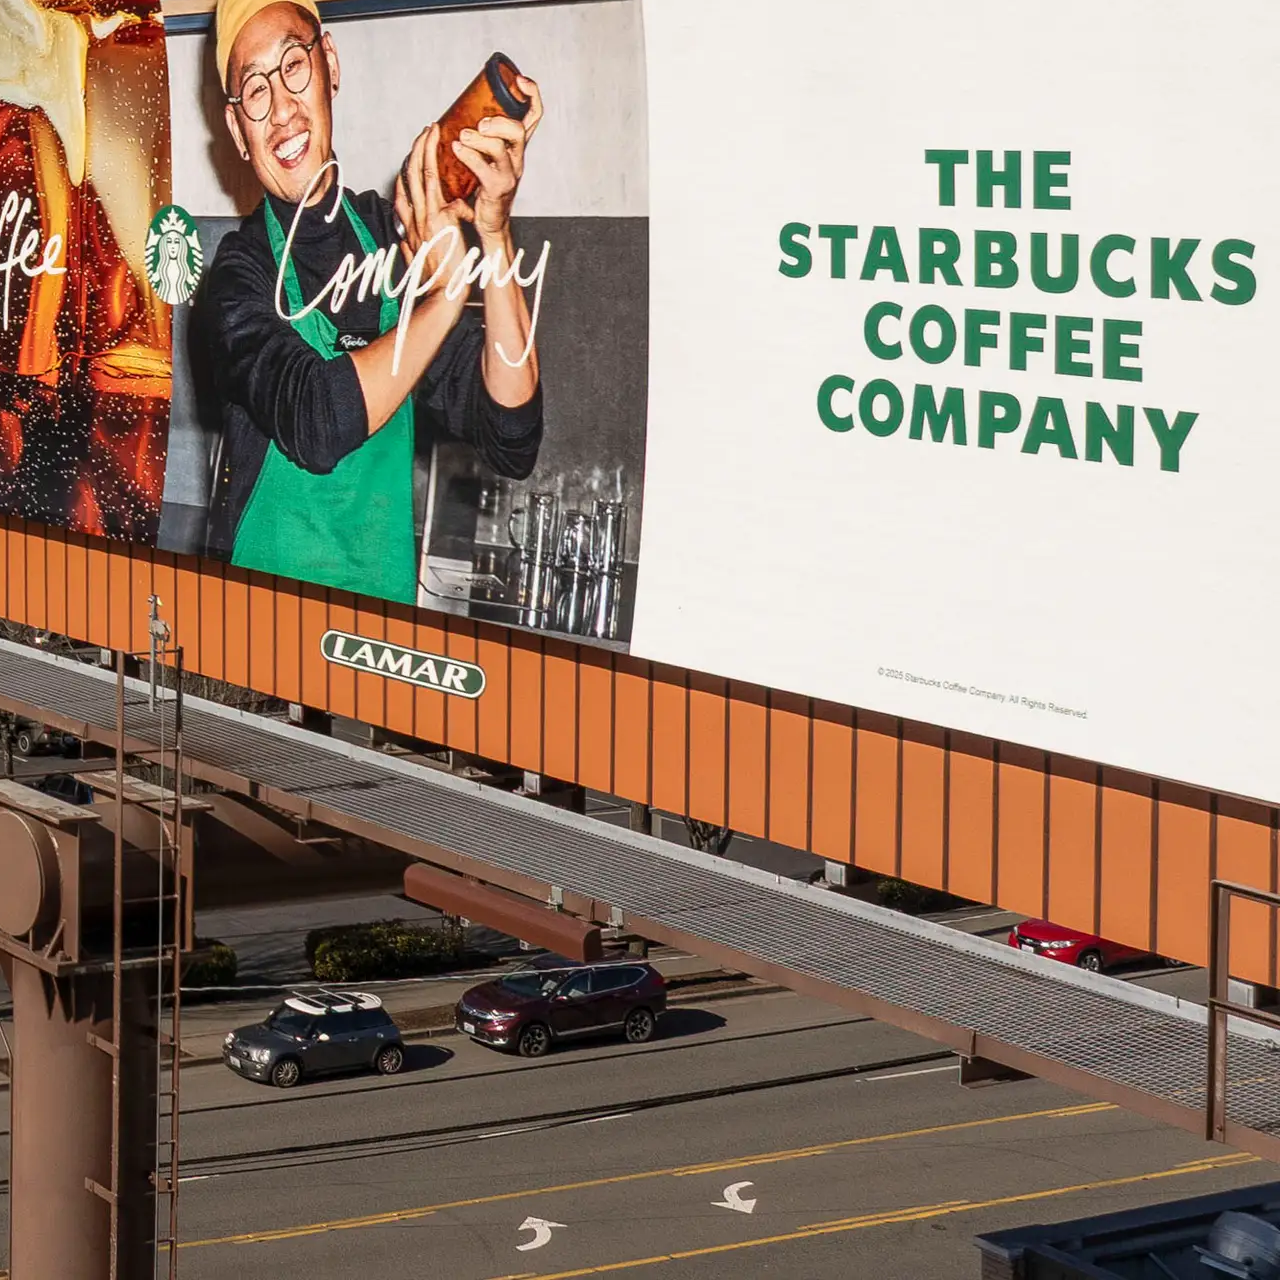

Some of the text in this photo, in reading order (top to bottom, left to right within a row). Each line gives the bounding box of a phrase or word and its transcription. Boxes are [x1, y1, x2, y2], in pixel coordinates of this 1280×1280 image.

[924, 149, 1072, 211] THE
[275, 159, 550, 376] Company
[777, 222, 1258, 306] STARBUCKS
[863, 301, 1143, 382] COFFEE
[816, 374, 1200, 473] COMPANY
[332, 636, 469, 692] LAMAR
[885, 668, 904, 680] 2025
[905, 672, 941, 688] Starbucks
[942, 680, 968, 694] Coffee
[1008, 694, 1019, 704] All
[1021, 696, 1046, 711] Rights
